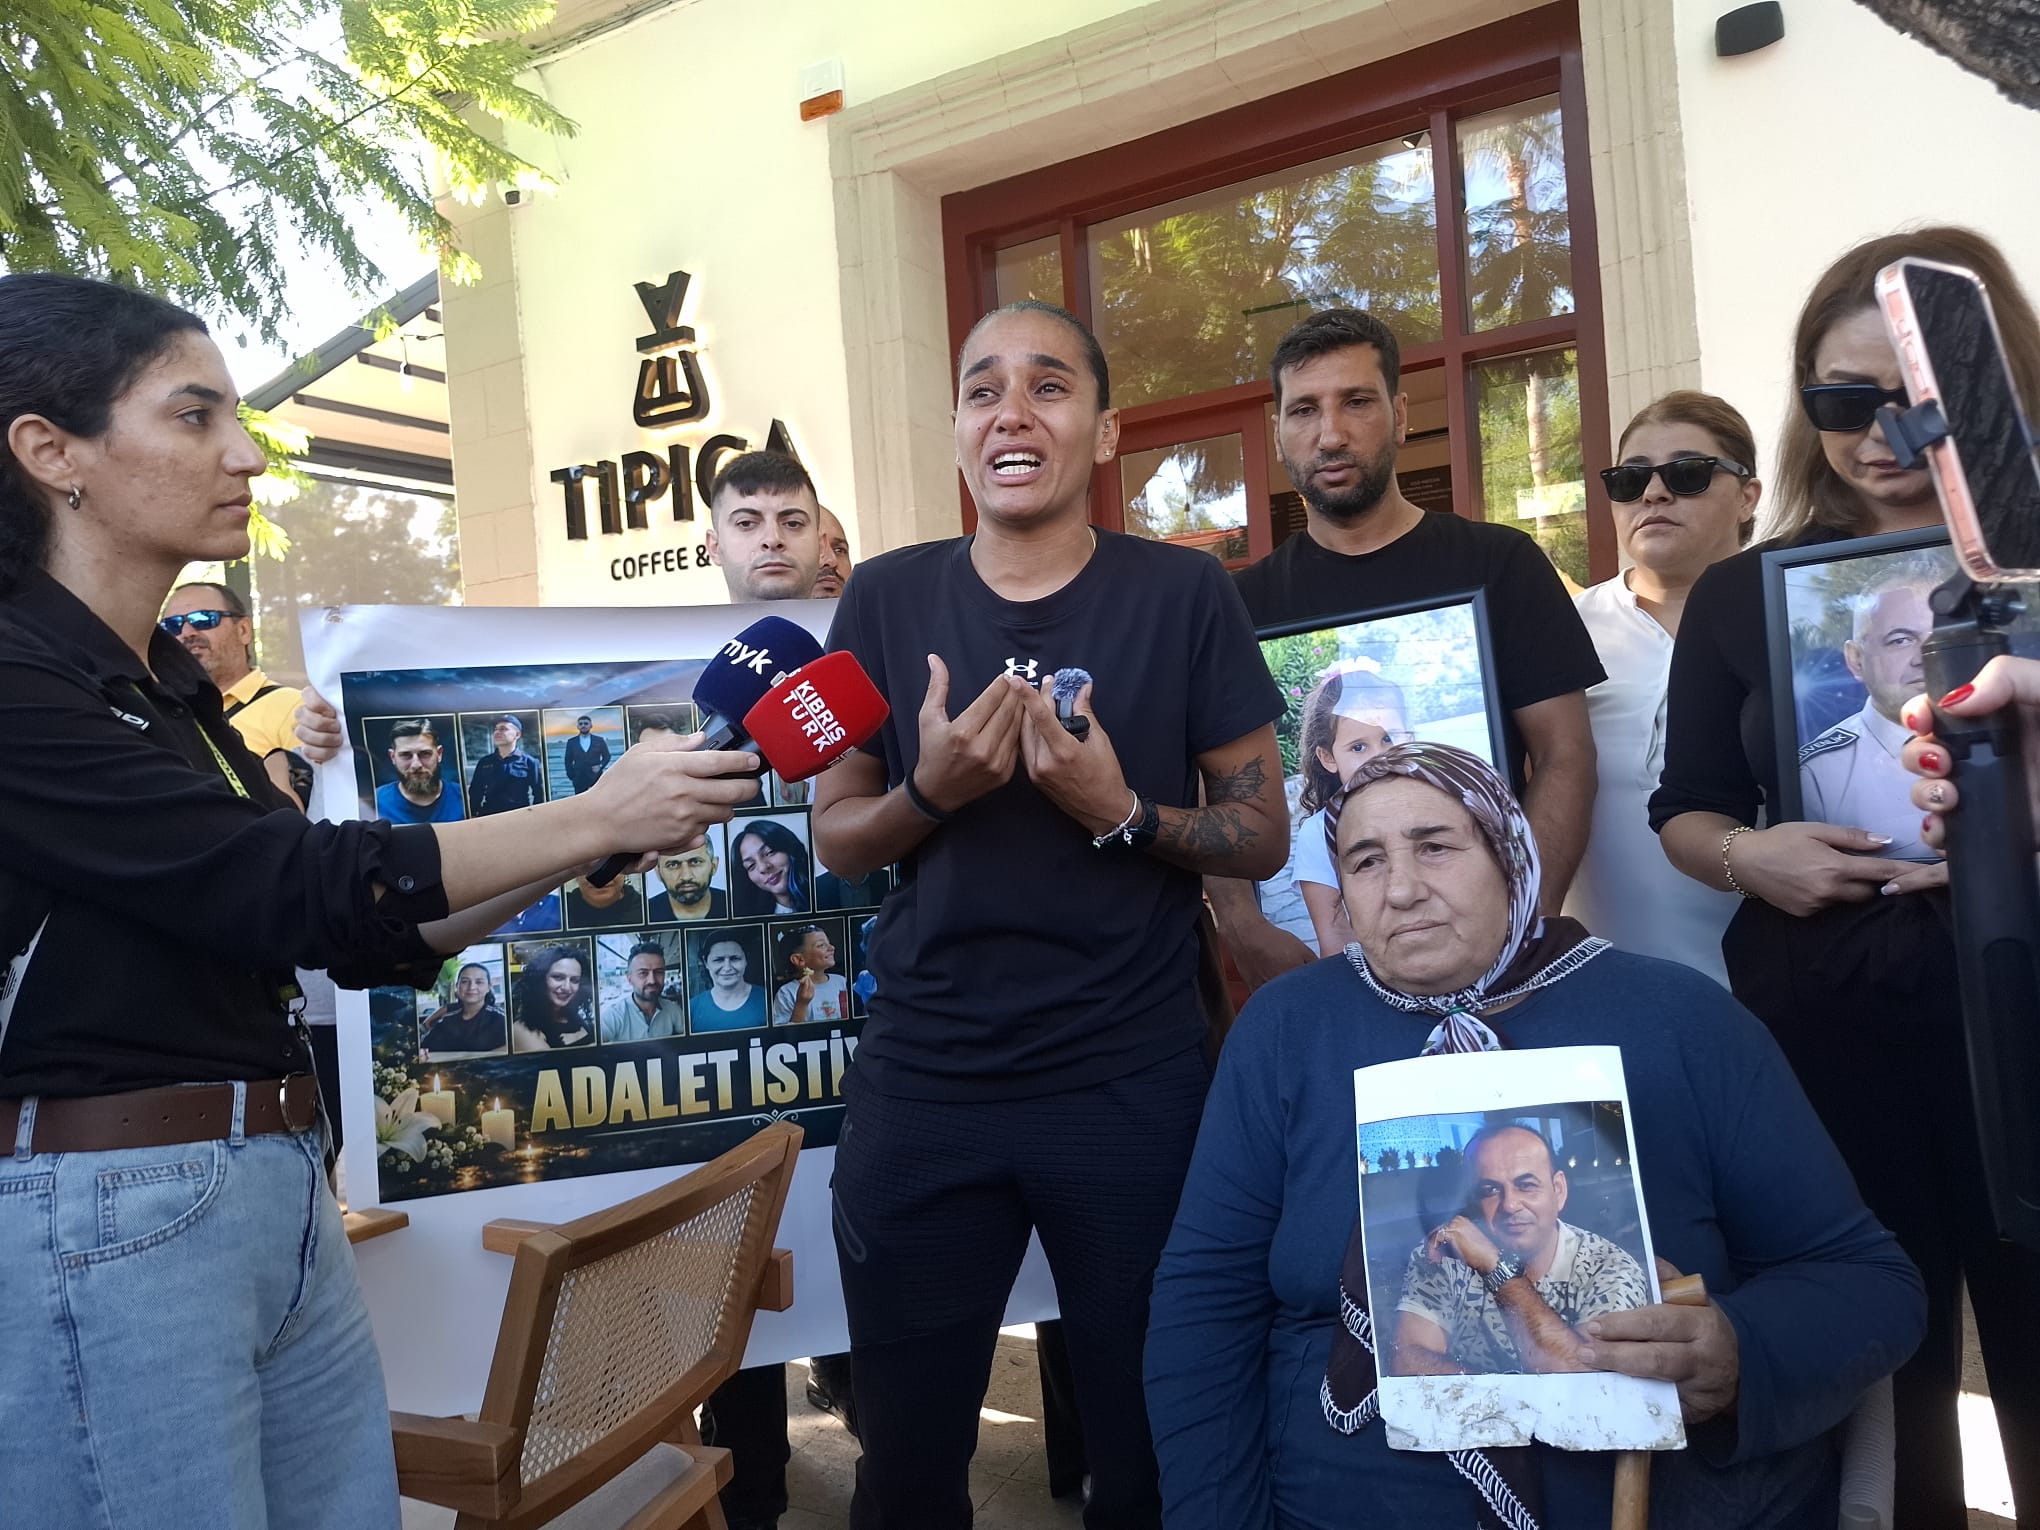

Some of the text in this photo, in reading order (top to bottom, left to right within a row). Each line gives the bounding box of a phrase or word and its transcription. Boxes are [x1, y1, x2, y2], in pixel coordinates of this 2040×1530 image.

[610, 544, 711, 581] COFFEE &
[723, 639, 773, 675] myk
[783, 690, 832, 753] TÜRK
[796, 680, 846, 742] KIBRIS
[530, 1048, 739, 1133] ADALET
